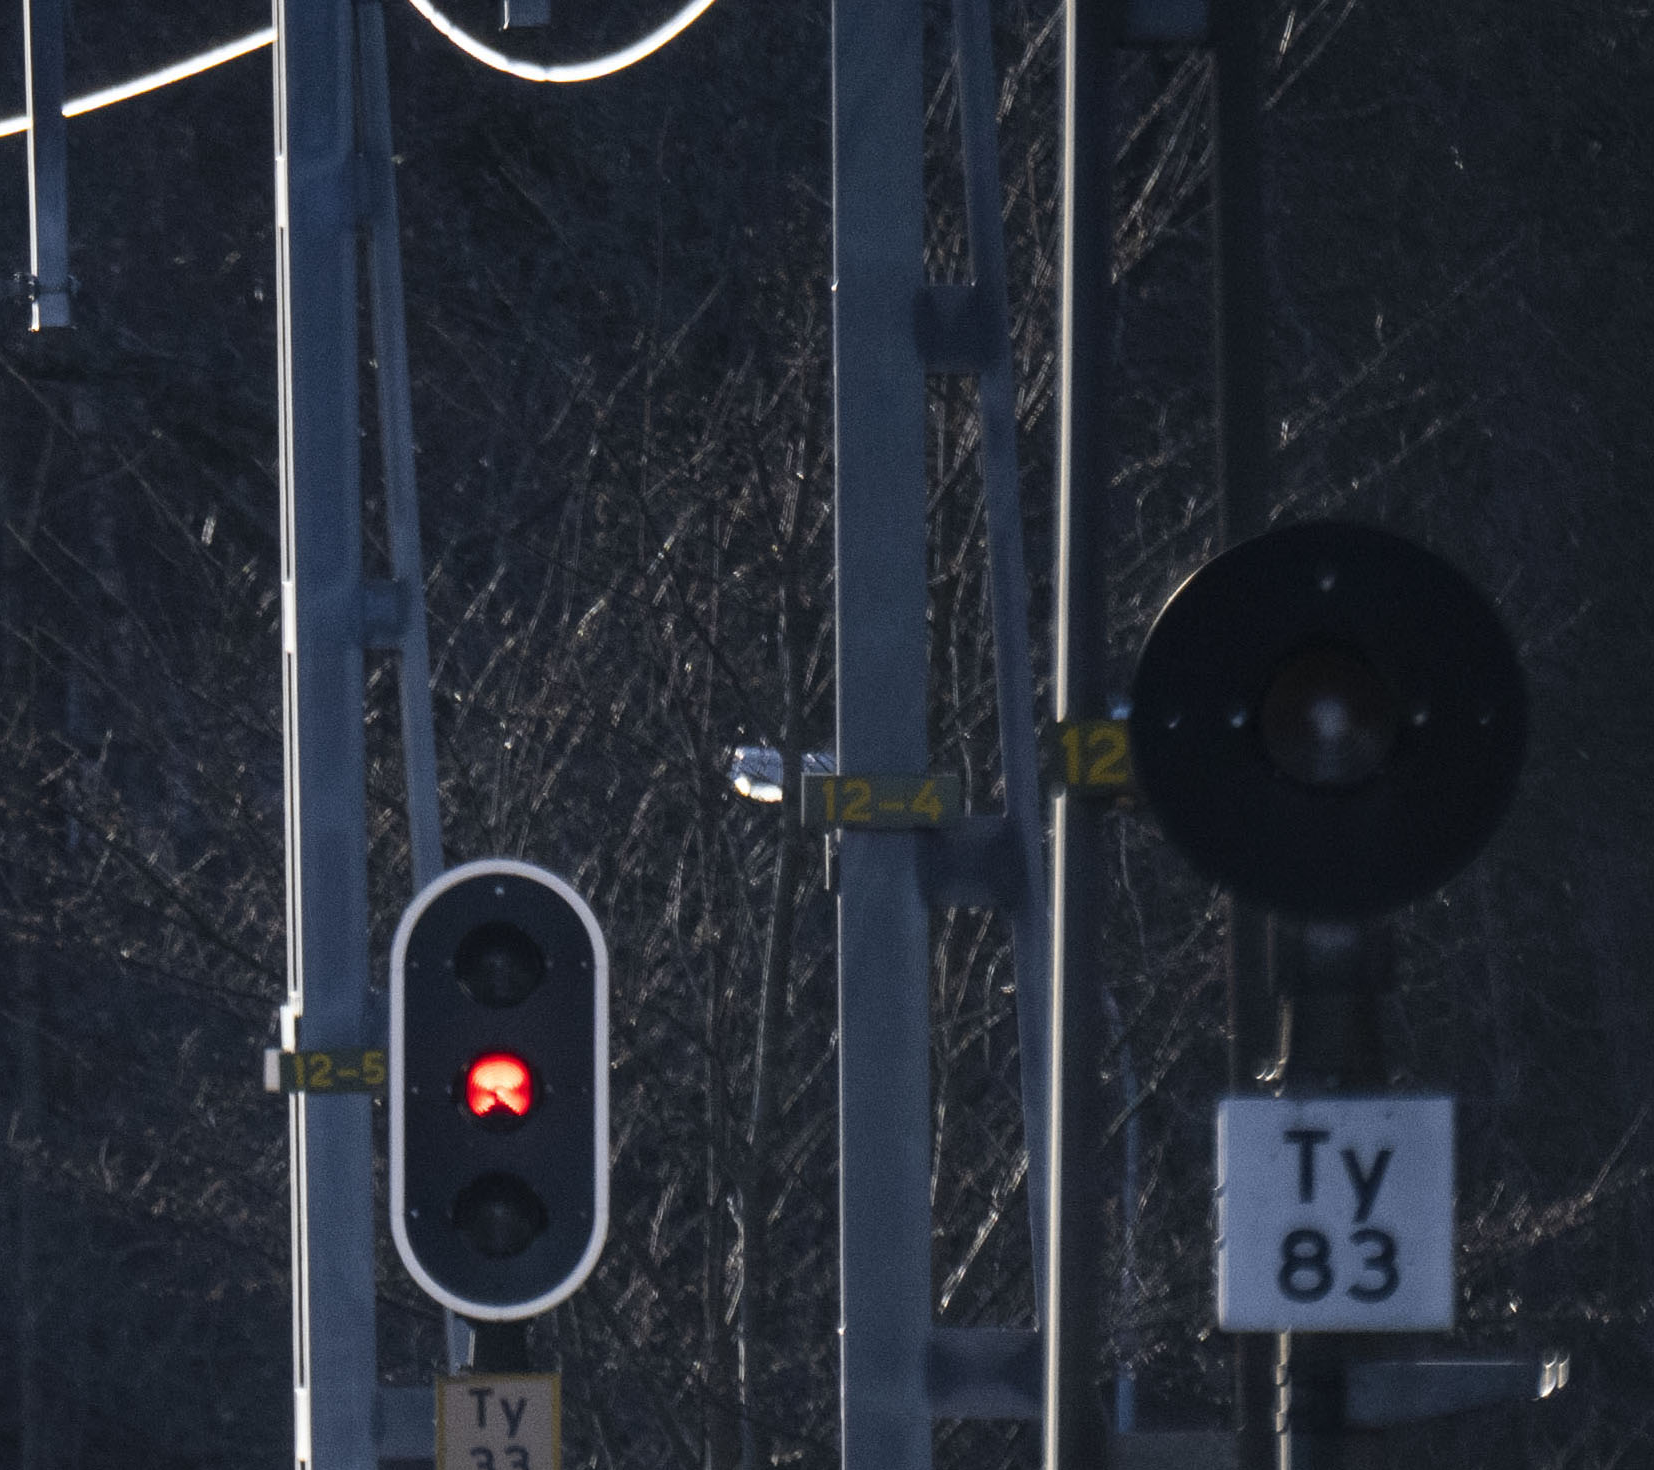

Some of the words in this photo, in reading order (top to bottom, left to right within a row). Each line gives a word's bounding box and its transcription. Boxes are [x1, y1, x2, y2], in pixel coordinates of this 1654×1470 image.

[822, 778, 944, 822] 12-4
[293, 1049, 386, 1088] 12-5
[1282, 1128, 1394, 1225] Ty
[1278, 1228, 1402, 1304] 83
[468, 1387, 528, 1438] Ty
